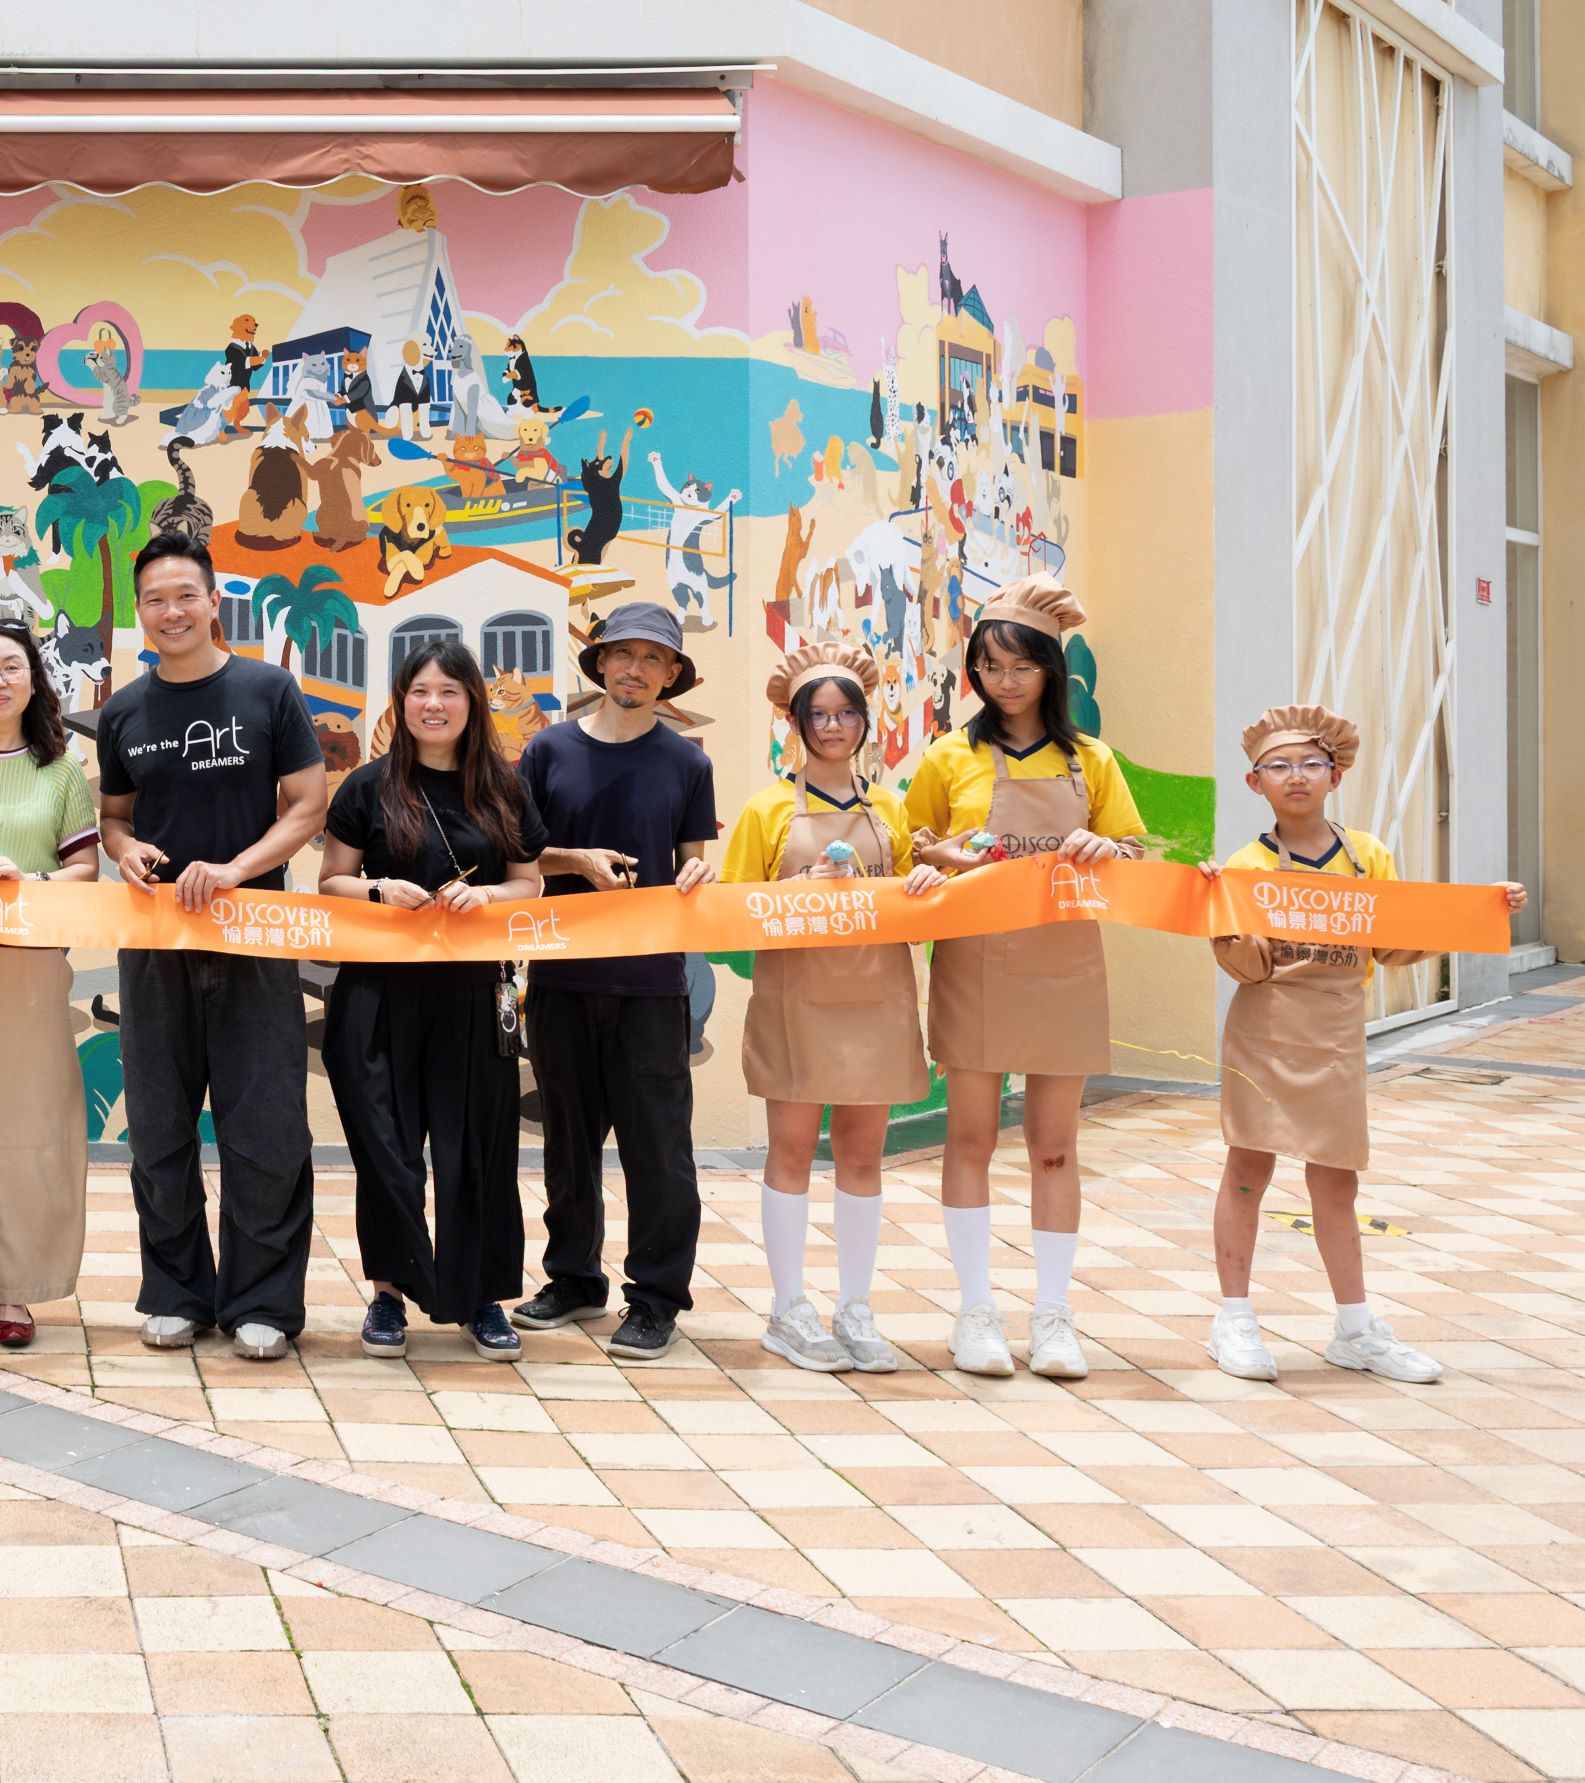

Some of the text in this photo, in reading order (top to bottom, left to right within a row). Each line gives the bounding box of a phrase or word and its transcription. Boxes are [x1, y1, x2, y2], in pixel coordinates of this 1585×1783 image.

[160, 739, 179, 750] the
[182, 716, 250, 758] Art
[191, 756, 245, 771] DREAMERS
[1000, 833, 1067, 854] DISCO
[1050, 863, 1109, 903] Art
[746, 890, 877, 919] DISCOVERY
[1058, 899, 1108, 910] DREAMERS
[1252, 881, 1379, 913] DISCOVERY
[210, 898, 333, 928] DISCOVERY
[830, 910, 878, 935] BAY
[1267, 909, 1328, 932] 愉景灣
[1330, 912, 1376, 936] BAY
[222, 925, 285, 946] 愉景灣
[507, 908, 570, 943] Art
[762, 915, 828, 937] 愉景灣
[287, 926, 333, 949] BAY
[517, 942, 567, 952] DREAMERS
[1280, 945, 1328, 964] 愉景灣
